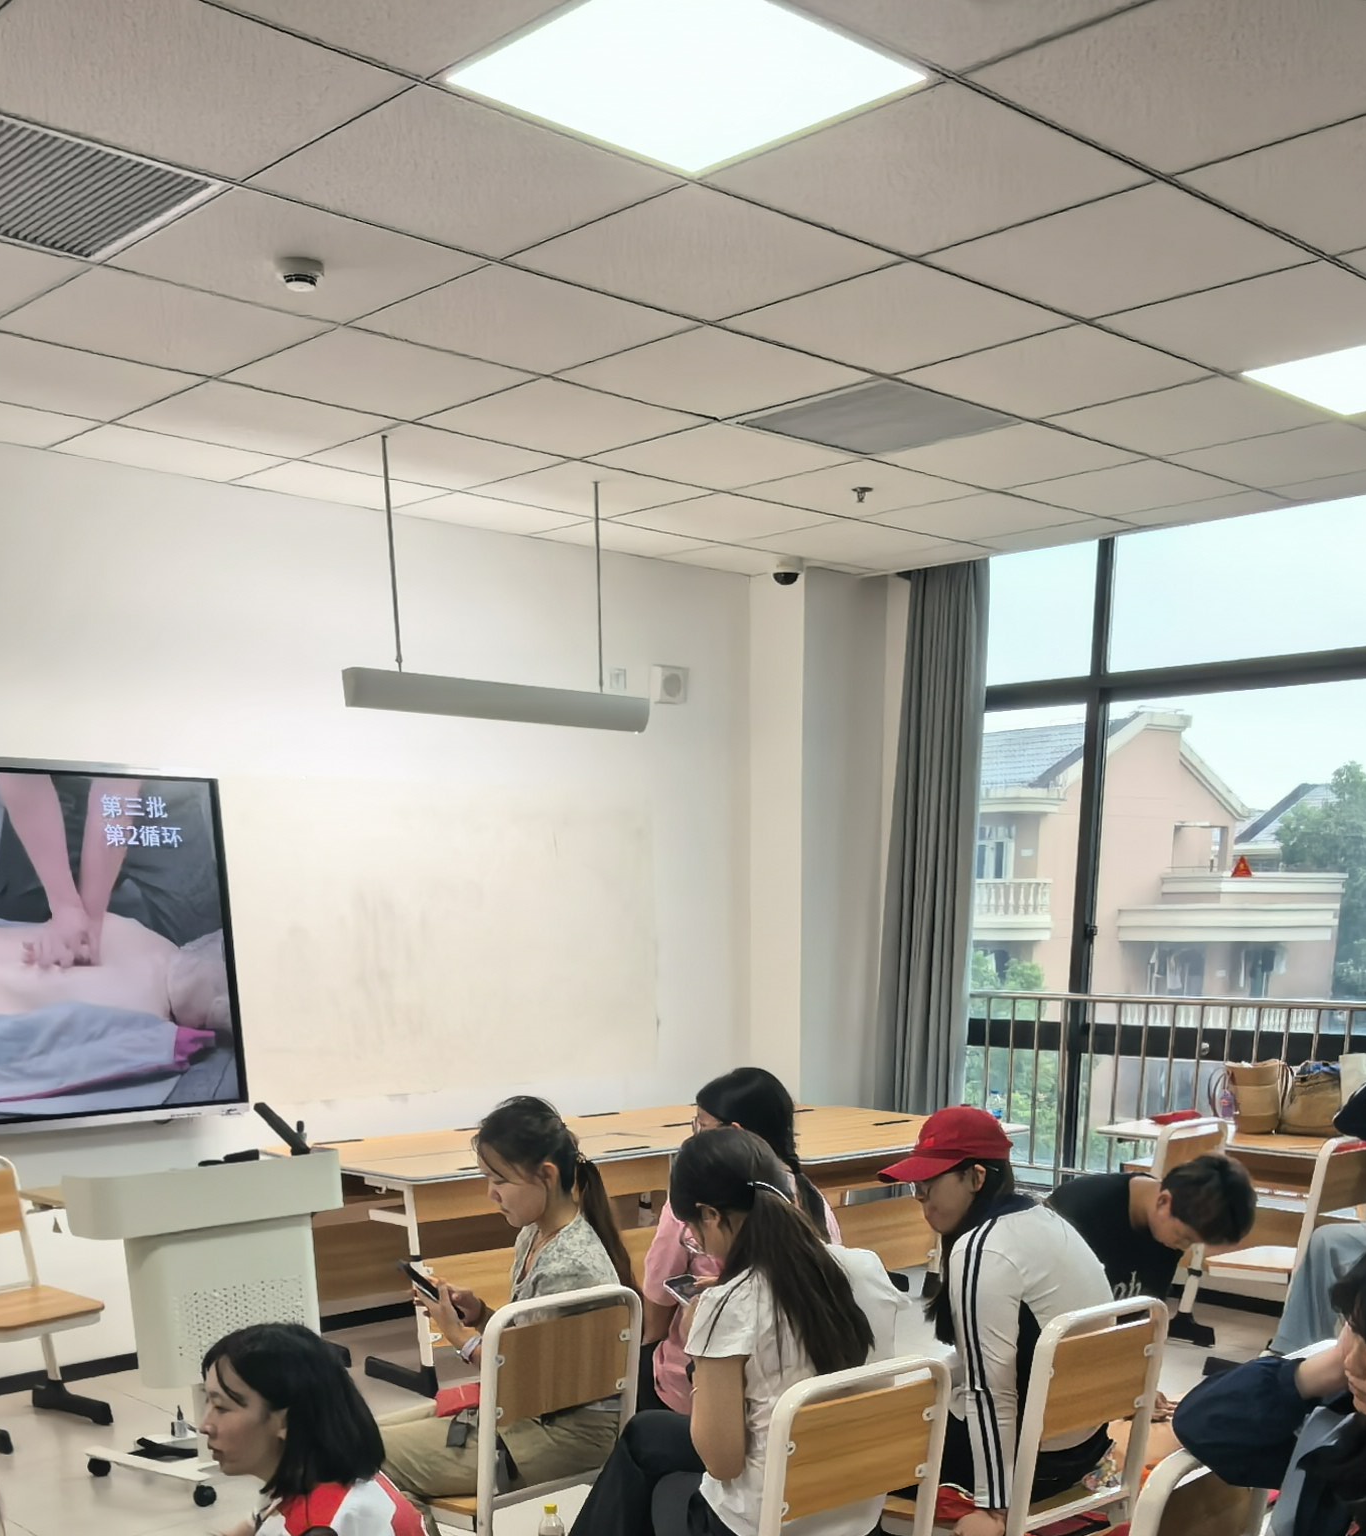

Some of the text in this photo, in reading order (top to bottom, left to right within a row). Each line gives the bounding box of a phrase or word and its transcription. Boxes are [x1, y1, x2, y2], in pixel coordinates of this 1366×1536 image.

[101, 794, 168, 818] 第三批
[104, 824, 183, 848] 第2循环
